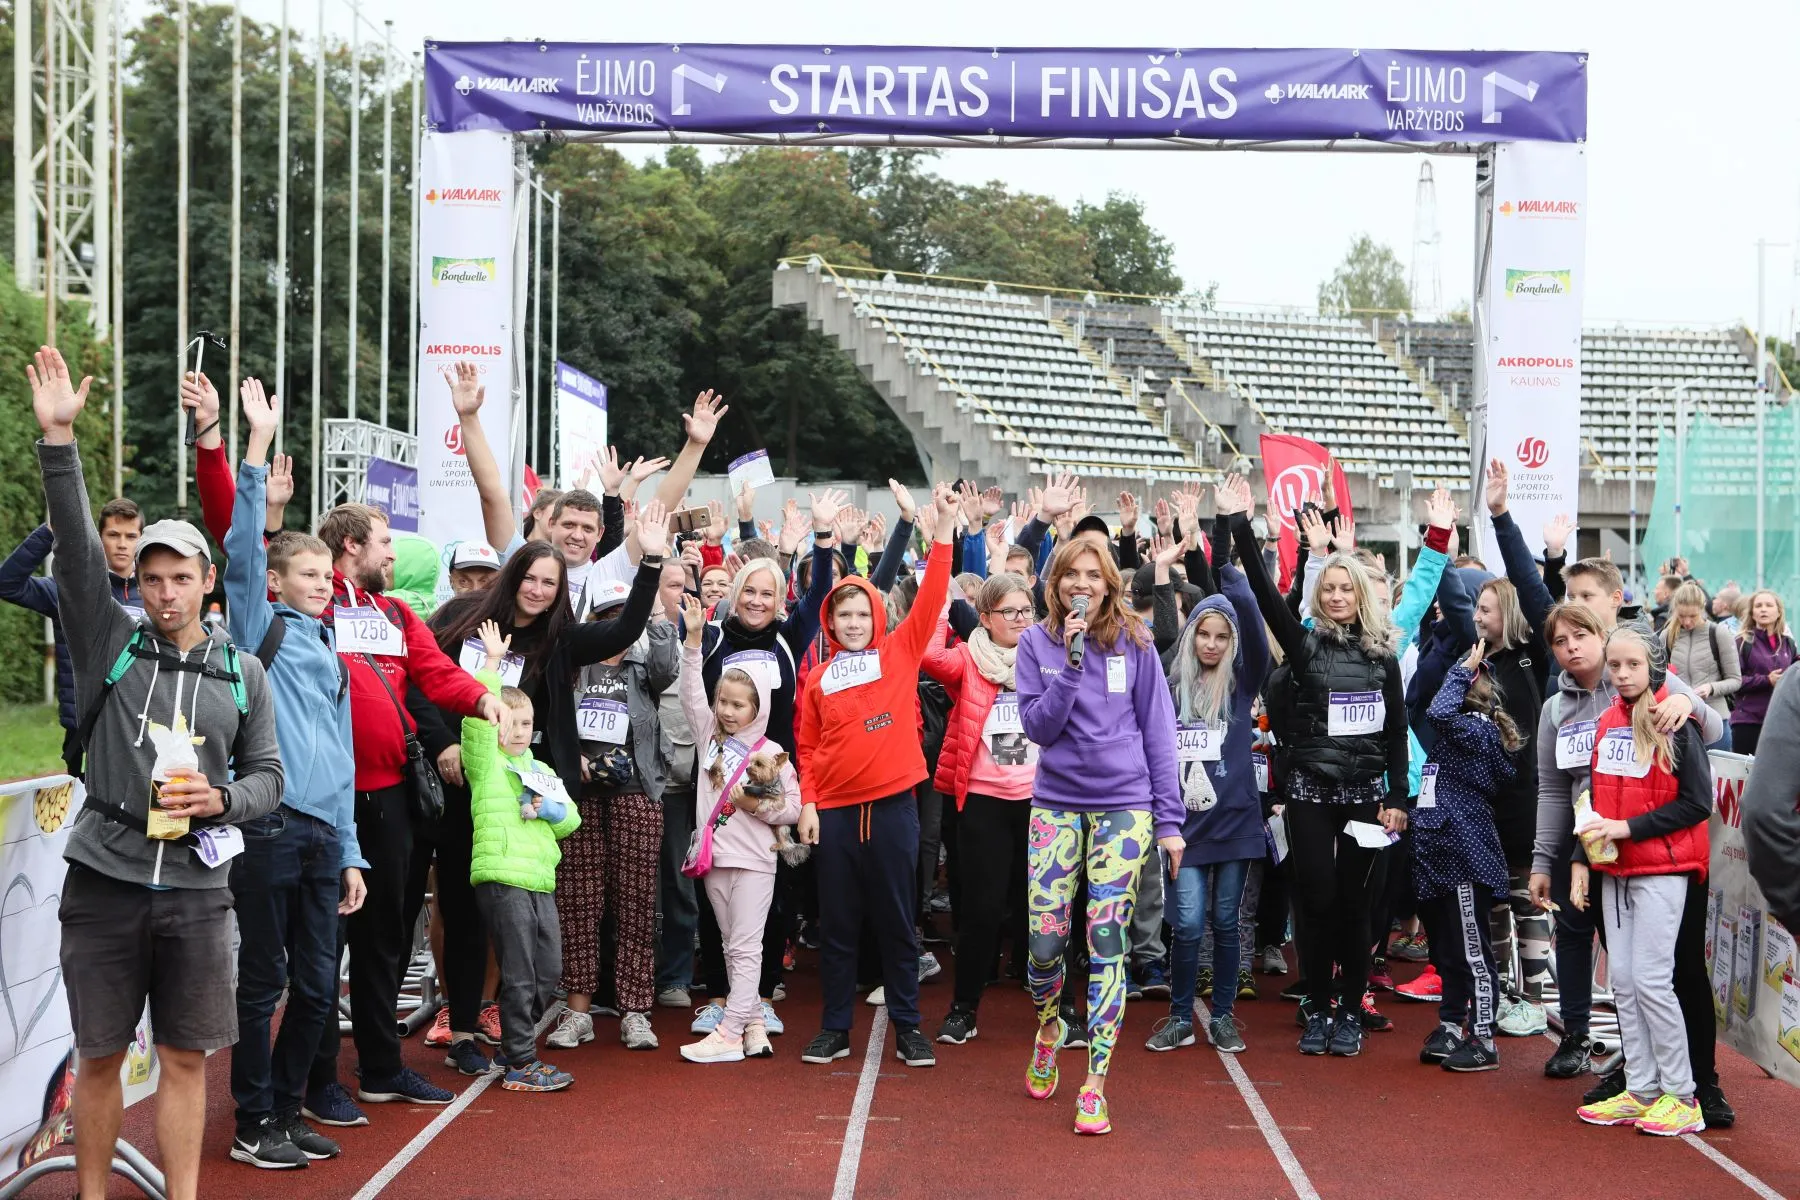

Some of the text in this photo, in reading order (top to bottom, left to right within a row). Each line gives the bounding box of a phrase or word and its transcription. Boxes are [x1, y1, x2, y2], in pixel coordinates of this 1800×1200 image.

[576, 53, 655, 96] ĖJIMO
[1386, 60, 1466, 103] ĖJIMO
[477, 77, 559, 93] WALMARK
[769, 55, 1238, 119] STARTAS FINIŠAS
[1287, 83, 1369, 100] WALMARK
[576, 100, 654, 124] VARŽYBOS
[1386, 107, 1464, 132] VARŽYBOS
[442, 188, 501, 202] WALMARK
[1518, 200, 1577, 213] WALMARK
[441, 270, 487, 283] Bonduelle
[1516, 283, 1562, 296] Bonduelle
[426, 345, 502, 355] AKROPOLIS
[1497, 357, 1574, 368] AKROPOLIS
[1510, 376, 1561, 387] KAUNAS
[1507, 493, 1563, 501] NIVERSITETAS
[350, 620, 388, 641] 1258
[831, 656, 867, 680] 0546
[582, 710, 617, 731] 1218
[995, 705, 1018, 722] 109
[1342, 704, 1375, 723] 1070
[1176, 731, 1208, 750] 3443
[1567, 732, 1594, 754] 360
[1459, 883, 1473, 918] GIRLS
[1465, 922, 1480, 958] SQUAD
